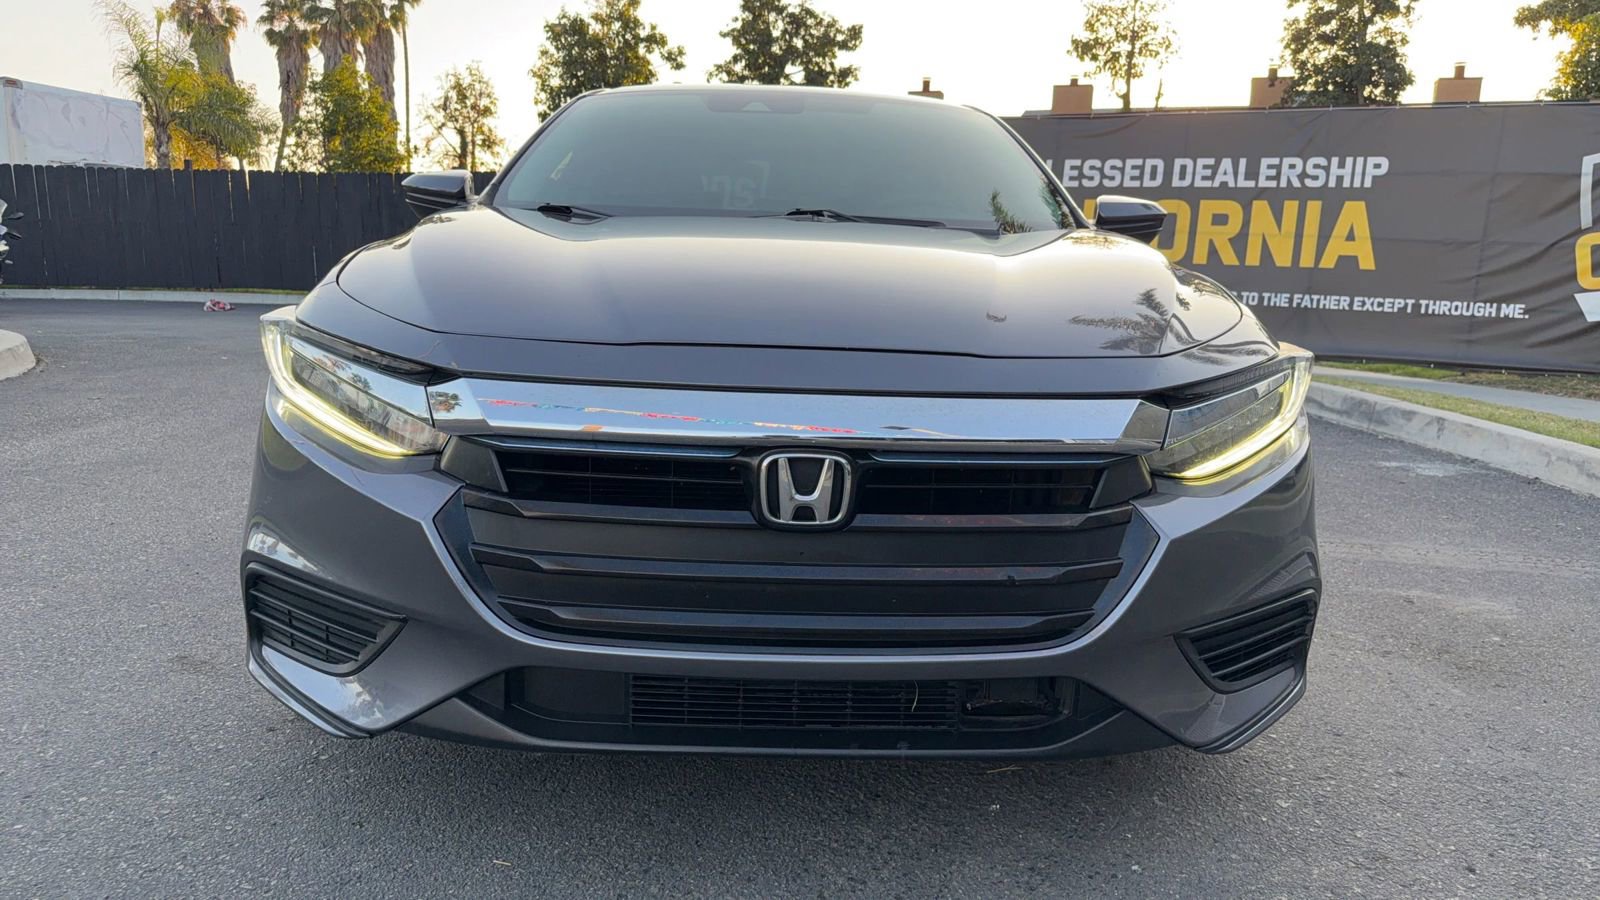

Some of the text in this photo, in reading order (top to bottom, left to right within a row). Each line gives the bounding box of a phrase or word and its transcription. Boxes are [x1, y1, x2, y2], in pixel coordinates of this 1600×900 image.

[1171, 156, 1390, 188] DEALERSHIP
[1083, 198, 1377, 271] ORNIA
[1241, 291, 1259, 306] TO
[1262, 292, 1291, 308] THE
[1292, 293, 1351, 310] FATHER
[1352, 296, 1415, 314] EXCEPT
[1418, 299, 1498, 318] THROUGH
[1499, 303, 1530, 319] ME.
